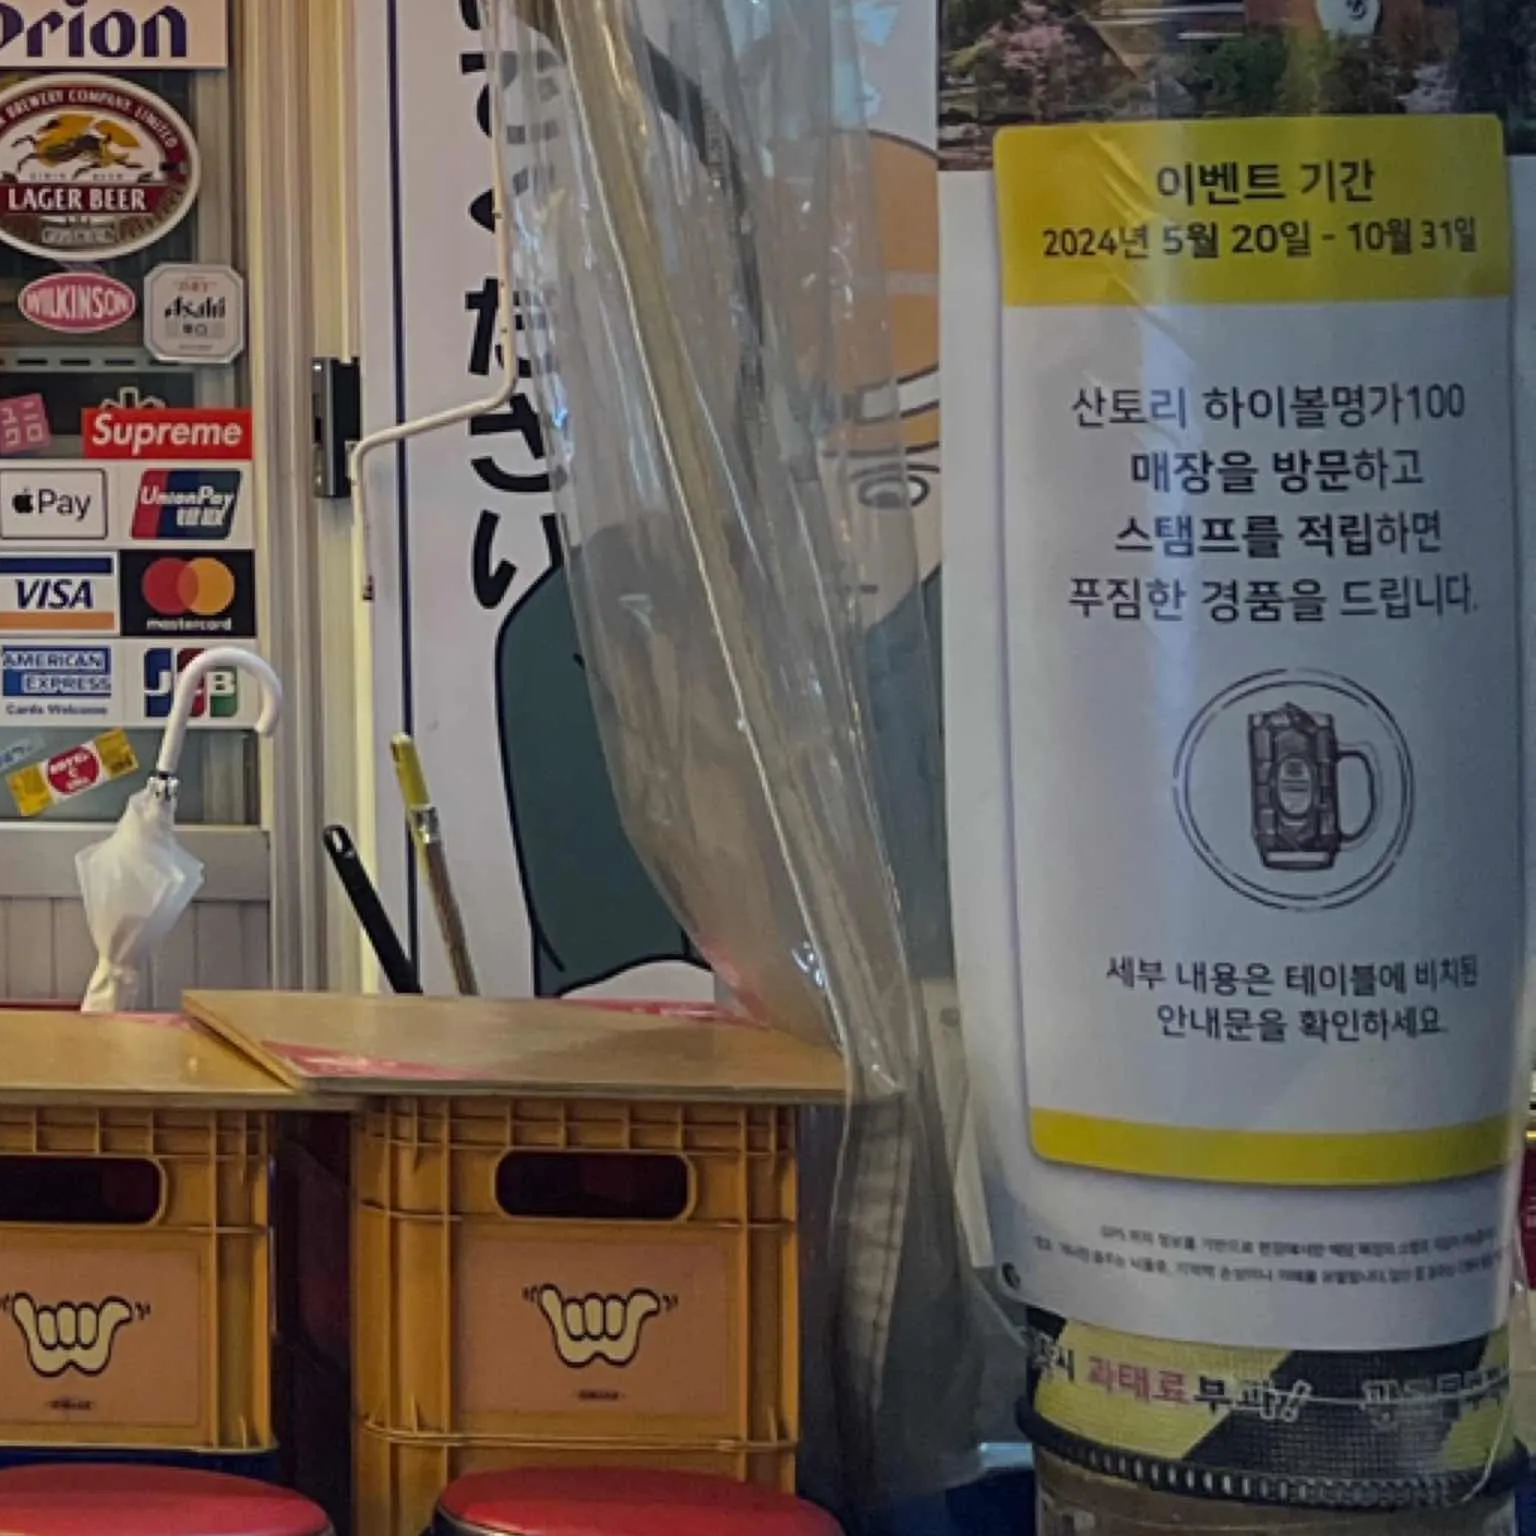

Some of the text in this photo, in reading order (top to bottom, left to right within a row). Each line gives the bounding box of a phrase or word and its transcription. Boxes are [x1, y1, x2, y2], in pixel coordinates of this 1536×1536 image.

[8, 187, 148, 212] LAGER BEER
[1156, 160, 1376, 206] 이벤트 기간
[1042, 224, 1150, 259] 2024년
[1163, 220, 1219, 259] 5월
[1232, 220, 1312, 257] 20일
[1350, 218, 1413, 254] 10월
[1421, 216, 1478, 252] 31일
[25, 284, 129, 320] WILKINSON
[164, 295, 226, 320] Asahi
[1072, 383, 1466, 430] 산토리 하이볼명가100
[90, 413, 244, 455] Supreme
[1131, 448, 1424, 495] 매장을 방문하고
[36, 487, 92, 520] Pay
[140, 484, 235, 509] UnionPay
[1115, 510, 1443, 559] 스탬프를 적립하면
[14, 579, 95, 610] VISA
[1069, 573, 1480, 624] 푸짐한 경품을 드립니다.
[146, 616, 232, 632] mastercard
[2, 653, 105, 669] AMERICAN
[24, 676, 112, 692] EXPRESS
[144, 671, 238, 696] JB
[1106, 956, 1167, 991] 세부
[1177, 961, 1274, 998] 내용은
[1285, 960, 1407, 998] 테이블에
[1156, 1005, 1448, 1042] 안내문을 확인하세요
